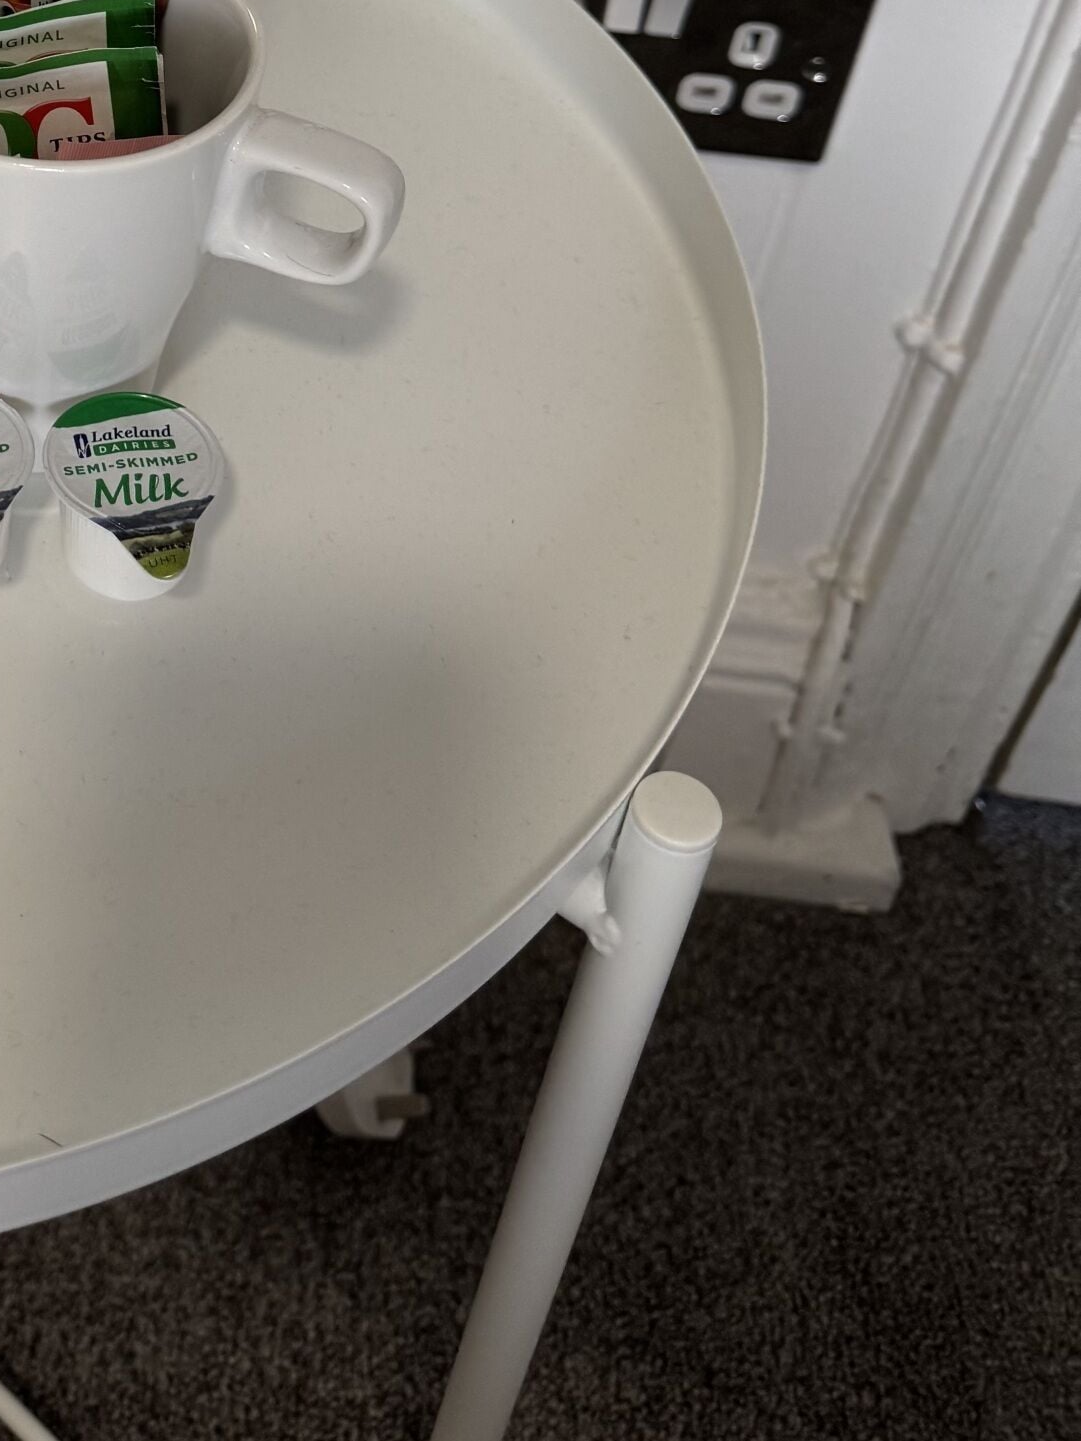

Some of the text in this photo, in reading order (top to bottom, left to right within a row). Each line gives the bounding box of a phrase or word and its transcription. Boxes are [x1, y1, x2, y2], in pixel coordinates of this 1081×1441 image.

[92, 424, 173, 443] Lakeland
[98, 440, 171, 454] DAIRIES
[63, 452, 199, 477] SEMI-SKIMMED
[94, 472, 189, 508] Milk
